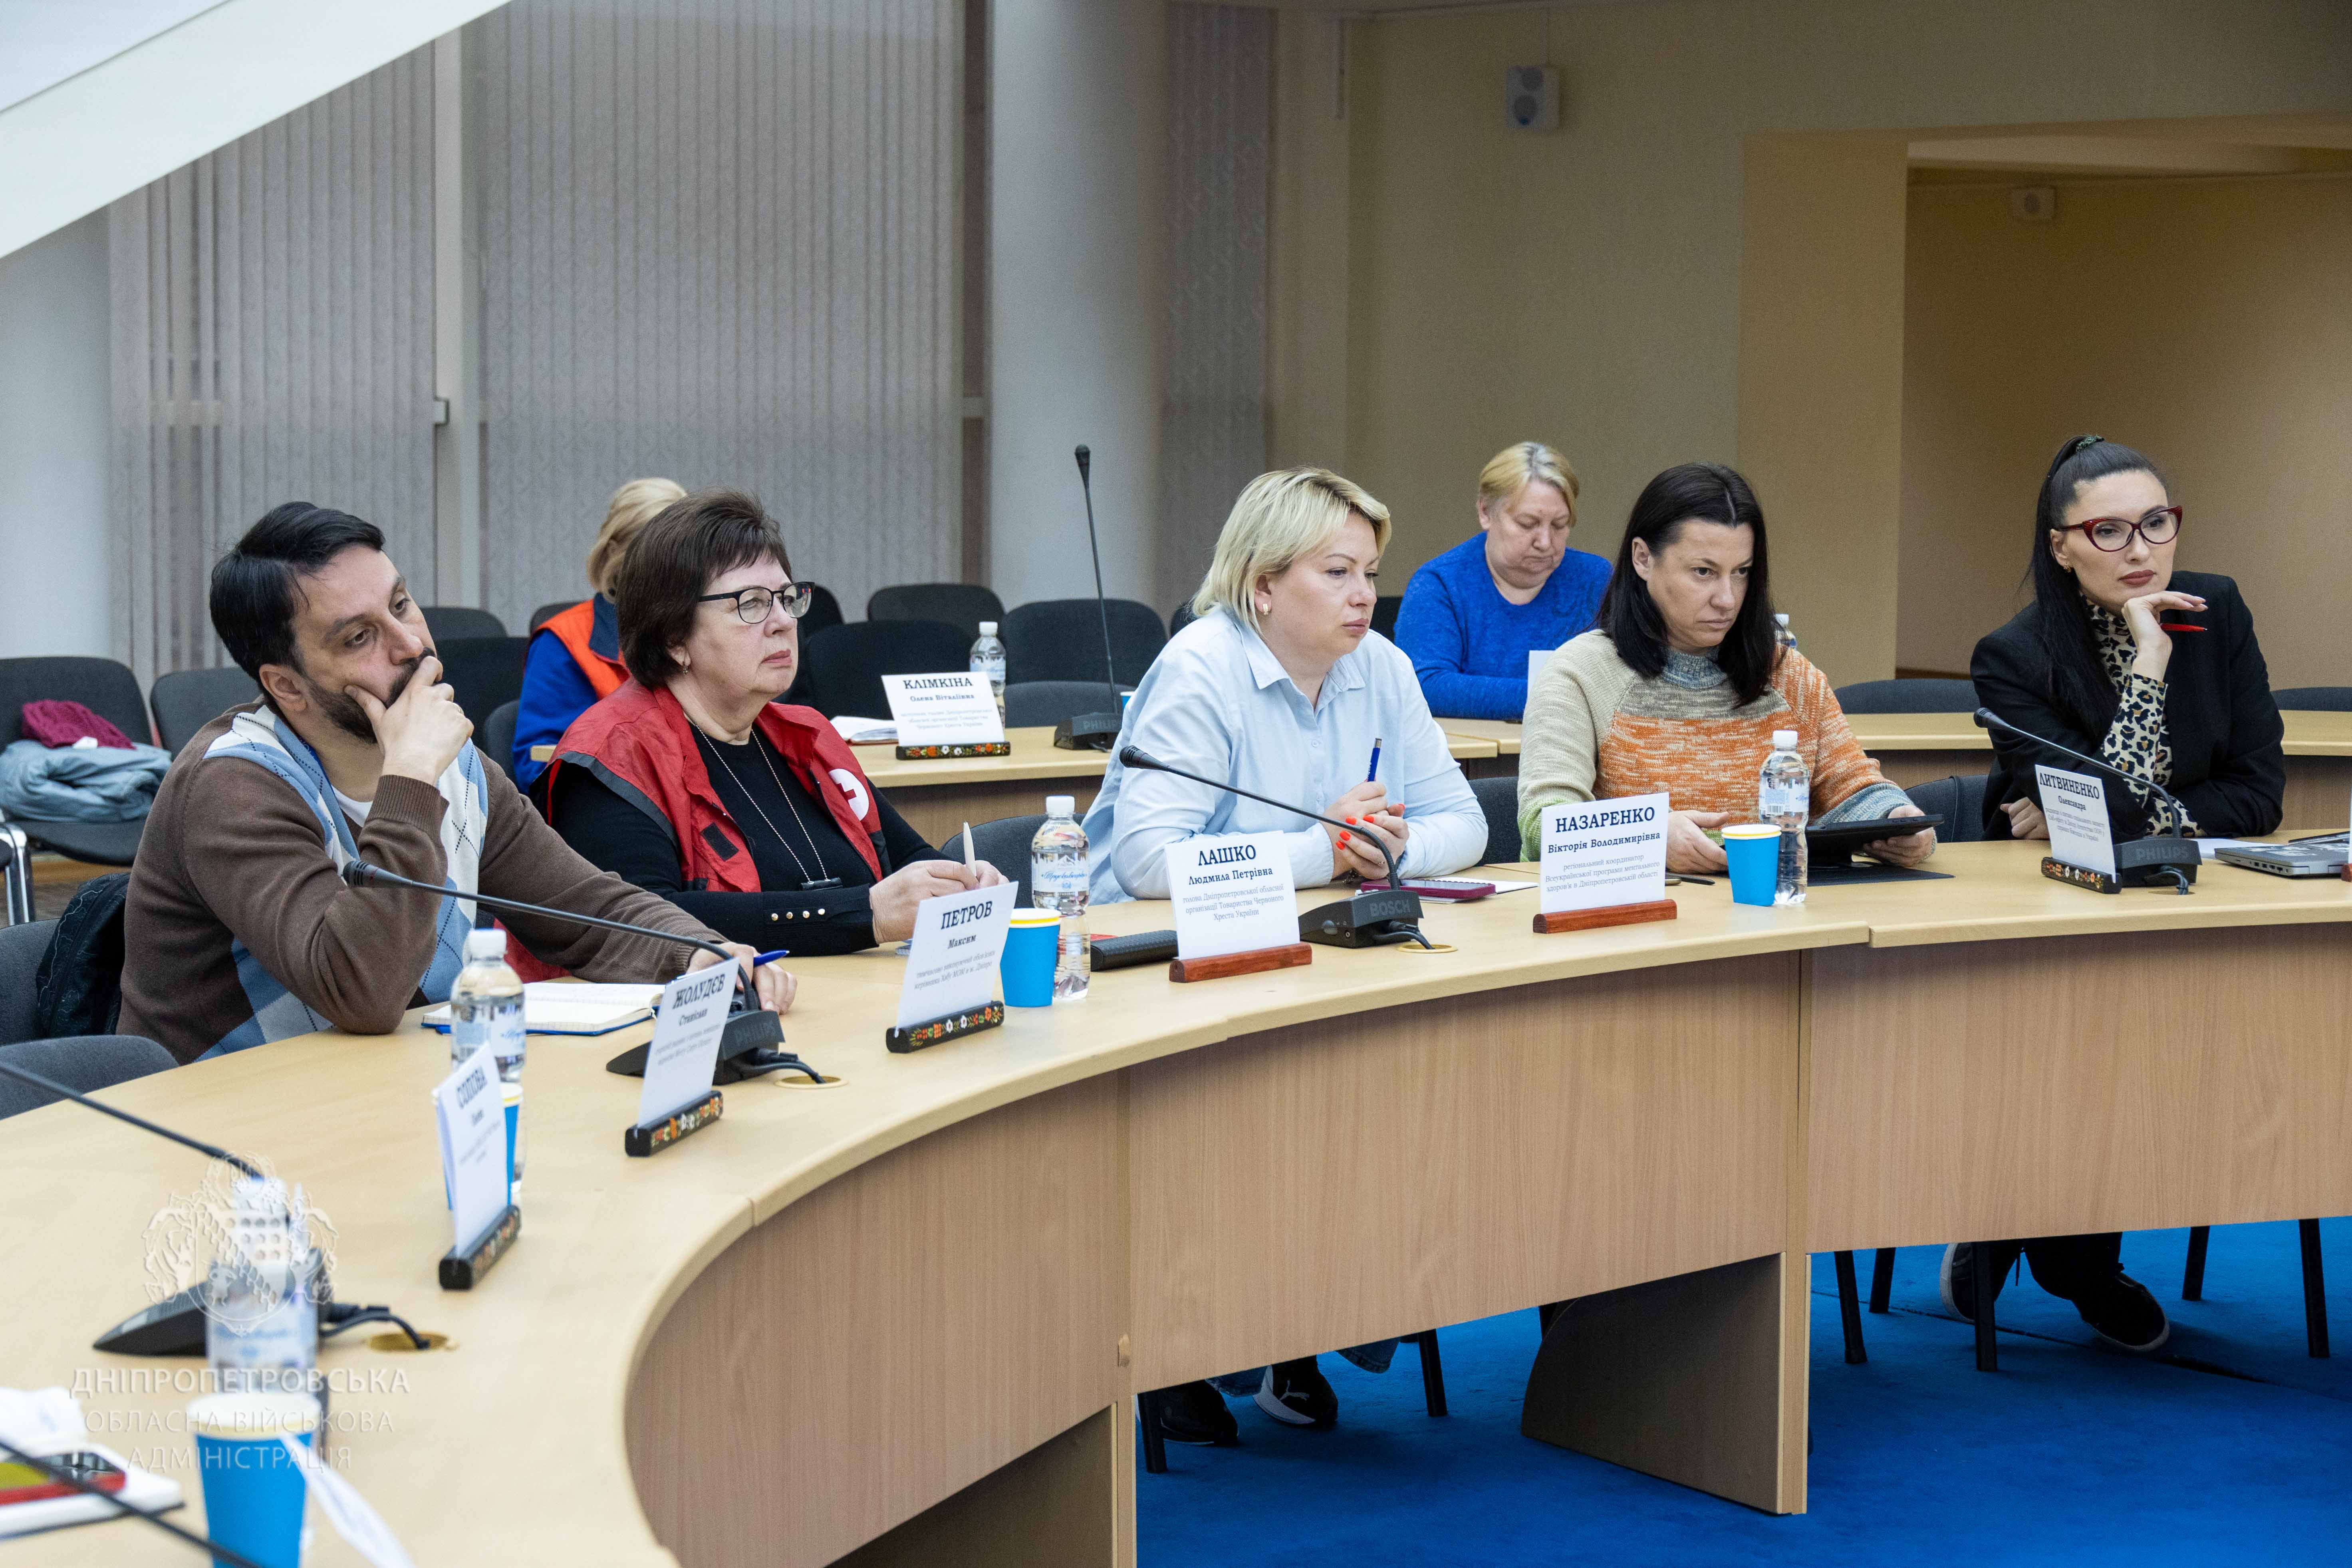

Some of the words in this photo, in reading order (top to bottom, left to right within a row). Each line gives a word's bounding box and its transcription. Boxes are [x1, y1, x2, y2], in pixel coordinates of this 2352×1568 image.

[903, 677, 973, 689] КЛІМКІНА
[1083, 719, 1119, 730] PHILIP
[2040, 772, 2100, 800] ЛИТВИНЕНКО
[1556, 807, 1655, 833] НАЗАРЕНКО
[1548, 841, 1588, 853] Вікторія
[1591, 832, 1661, 848] Володимирівна
[1198, 845, 1256, 866] ЛАШКО
[1563, 859, 1604, 871] регіональний
[1606, 854, 1644, 865] координатор
[2136, 846, 2189, 861] PHILIPS
[1189, 873, 1230, 885] Людмила
[1233, 867, 1273, 880] Петрівна
[1546, 870, 1592, 883] Всеукраїнської
[1593, 867, 1624, 877] програми
[1625, 861, 1660, 871] ментального
[1579, 875, 1636, 888] Дніпропетровській
[1637, 871, 1658, 879] області
[1183, 895, 1202, 903] голова
[1203, 888, 1258, 902] Дніпропетровської
[1259, 884, 1284, 893] обласної
[1185, 902, 1218, 914] організації
[1219, 899, 1252, 910] Товариства
[1254, 895, 1284, 906] Червоного
[1370, 899, 1411, 917] BOSCH
[941, 901, 992, 930] ПЕТРОВ
[1214, 912, 1234, 922] Хреста
[1235, 909, 1259, 919] України
[948, 935, 977, 949] Максим
